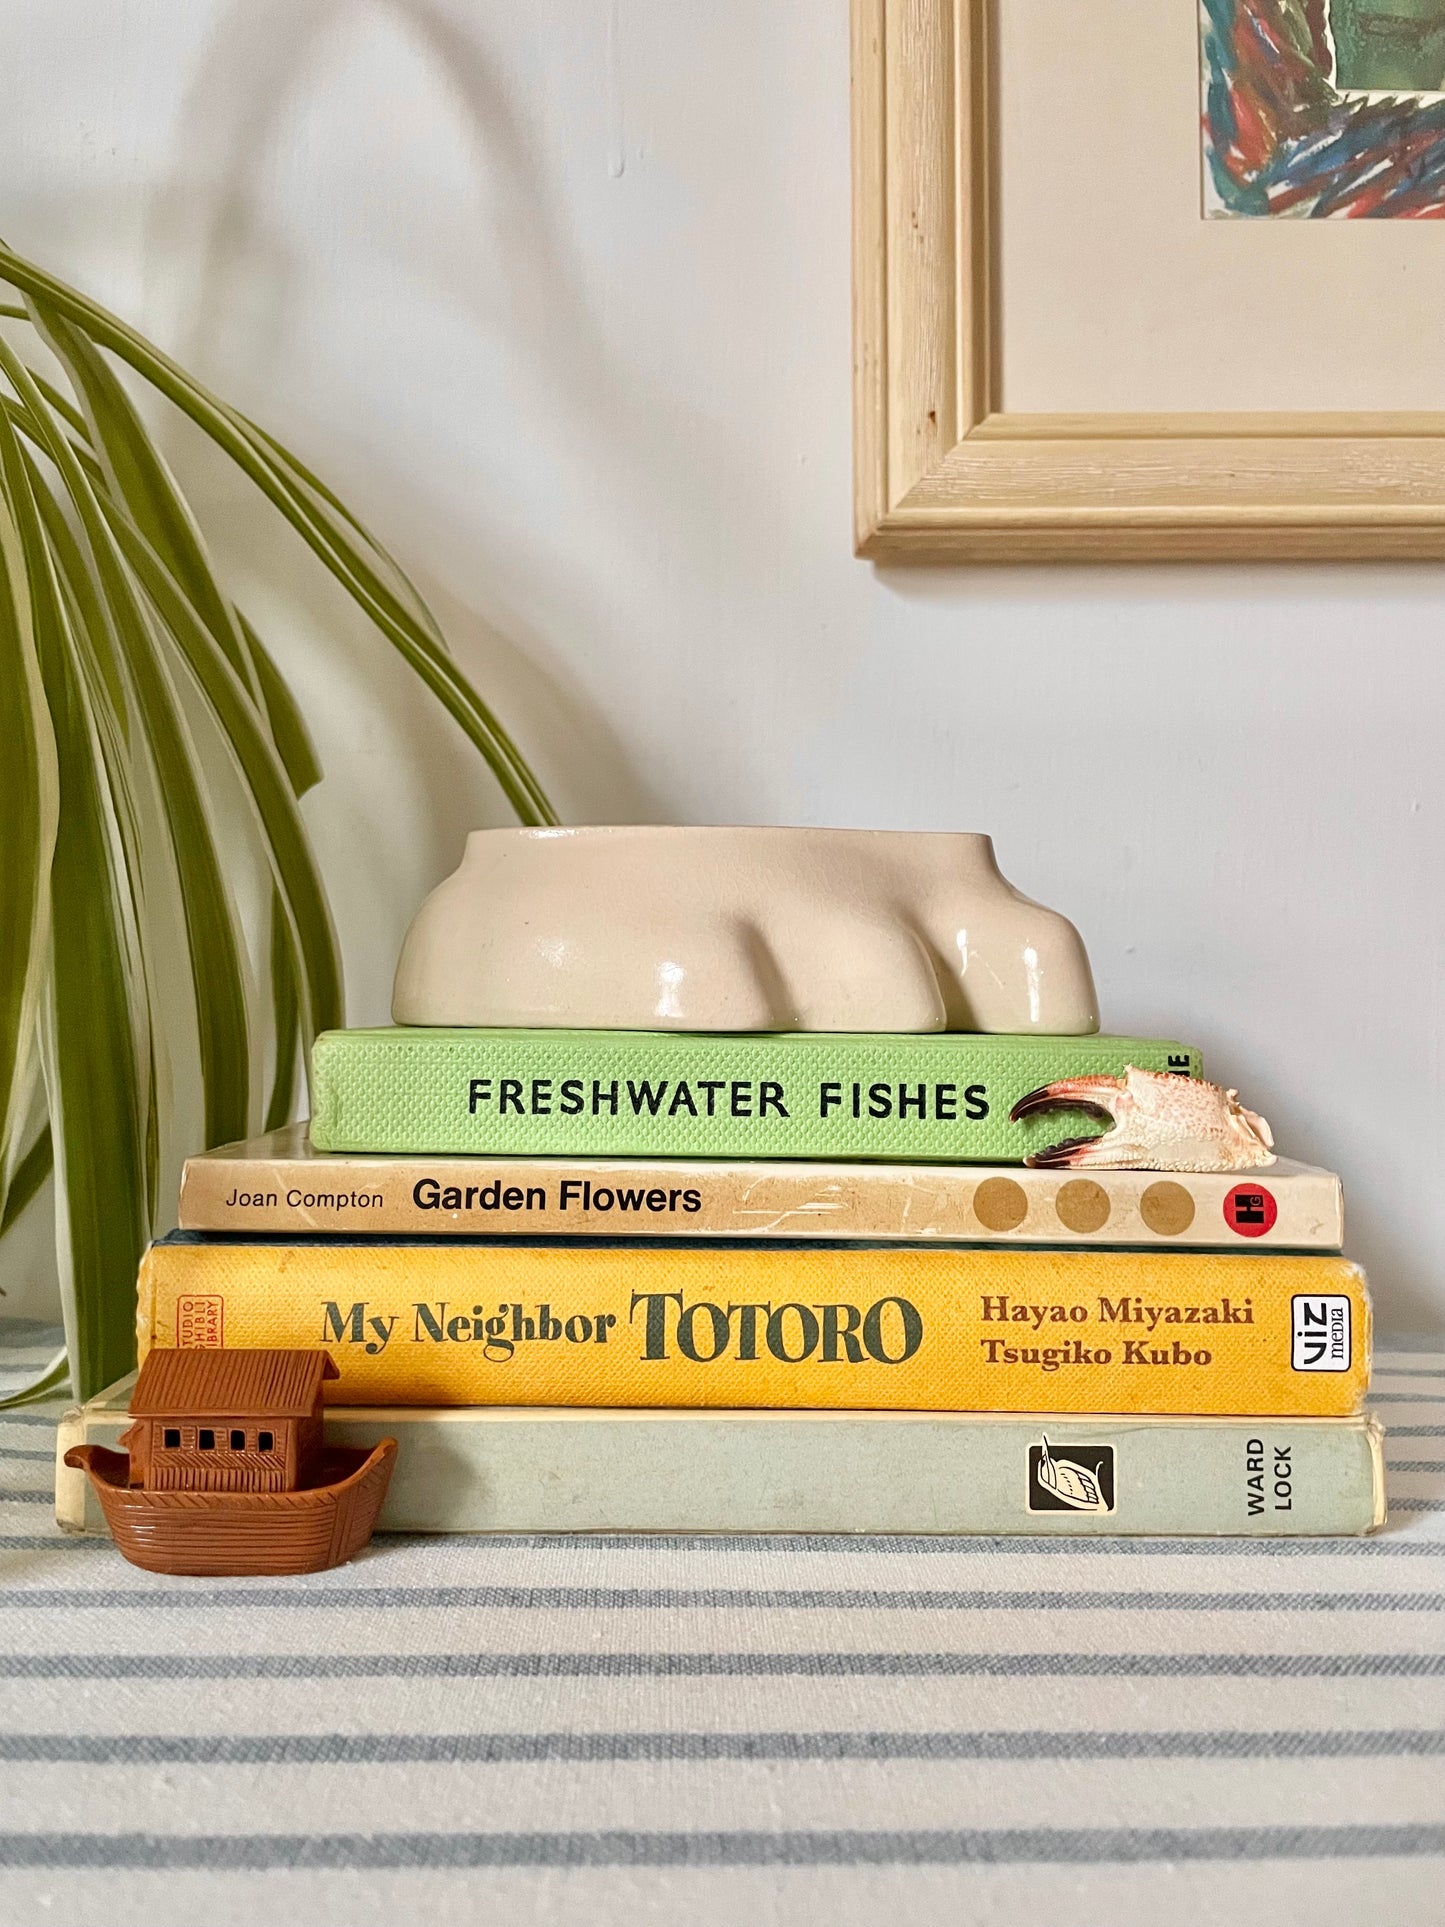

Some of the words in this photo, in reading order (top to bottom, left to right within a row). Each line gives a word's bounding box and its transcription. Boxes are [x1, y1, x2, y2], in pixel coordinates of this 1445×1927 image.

[469, 1079, 790, 1118] FRESHWATER
[820, 1082, 989, 1120] FISHES
[226, 1188, 278, 1208] Joan
[286, 1189, 384, 1211] Compton
[413, 1178, 546, 1211] Garden
[560, 1180, 702, 1213] Flowers
[182, 1301, 193, 1348] TUDIO
[206, 1300, 218, 1348] IBRARY
[321, 1301, 399, 1355] My
[411, 1302, 616, 1363] Neighbor
[629, 1288, 923, 1364] TOTORO
[980, 1295, 1088, 1330] Hayao
[1098, 1297, 1255, 1331] Miyazaki
[980, 1339, 1112, 1371] Tsugiko
[1121, 1341, 1212, 1366] Kubo
[1246, 1438, 1265, 1516] WARD
[1274, 1446, 1292, 1511] LOCK
